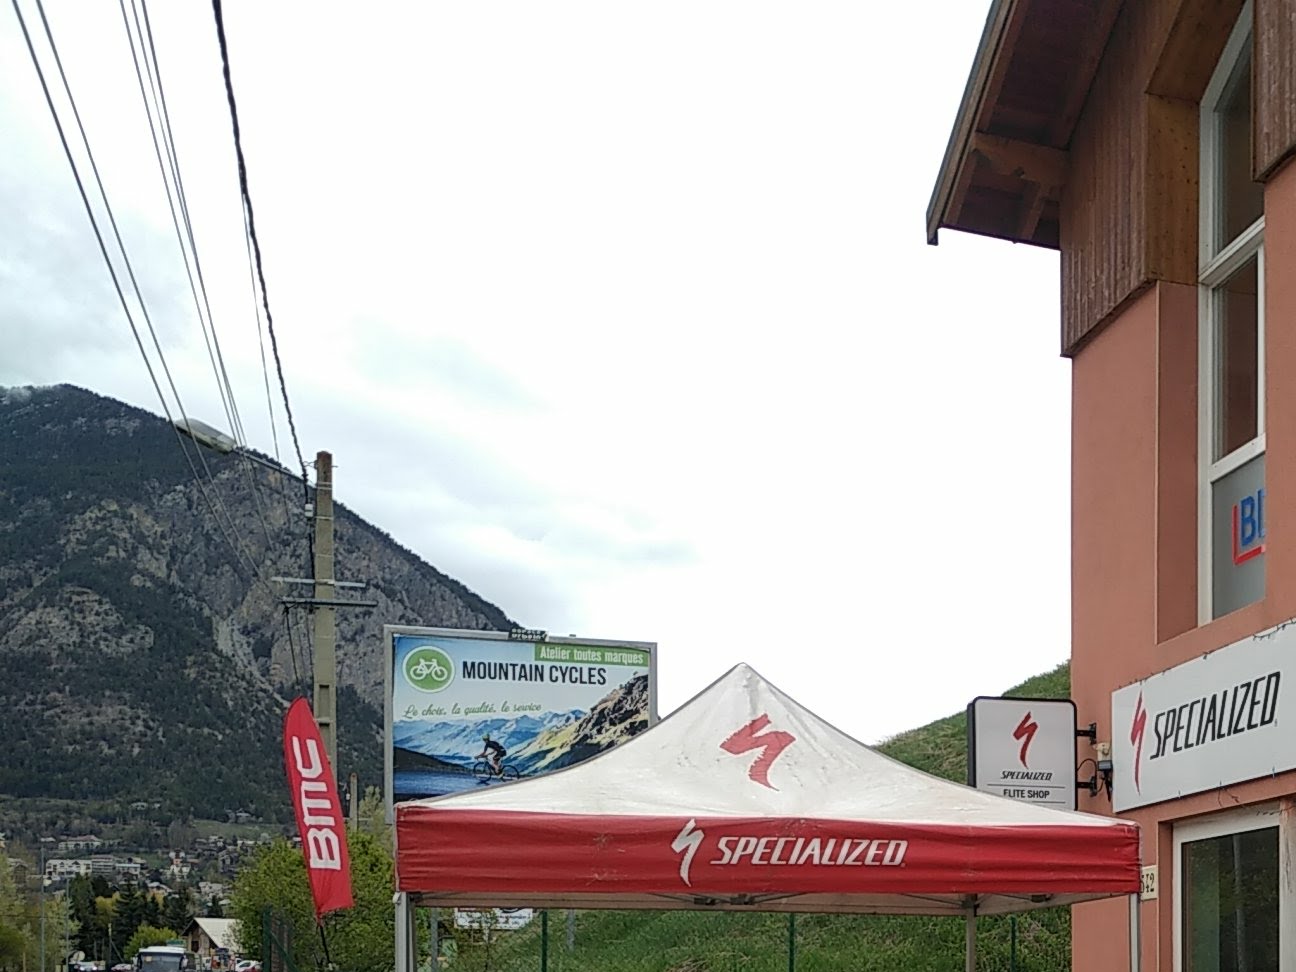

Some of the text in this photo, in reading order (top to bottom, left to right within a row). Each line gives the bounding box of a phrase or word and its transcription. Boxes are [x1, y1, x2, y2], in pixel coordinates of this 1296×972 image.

[539, 646, 644, 665] Atelier toutes marques
[462, 660, 607, 685] MOUNTAIN CYCLES
[451, 702, 461, 715] la
[501, 701, 510, 713] le
[1149, 671, 1281, 760] SPECIALIZED
[1000, 770, 1053, 781] SPECIALIZED
[292, 736, 341, 871] BMC
[1003, 789, 1050, 799] ELITE SHOP
[710, 835, 908, 867] SPECIALIZED
